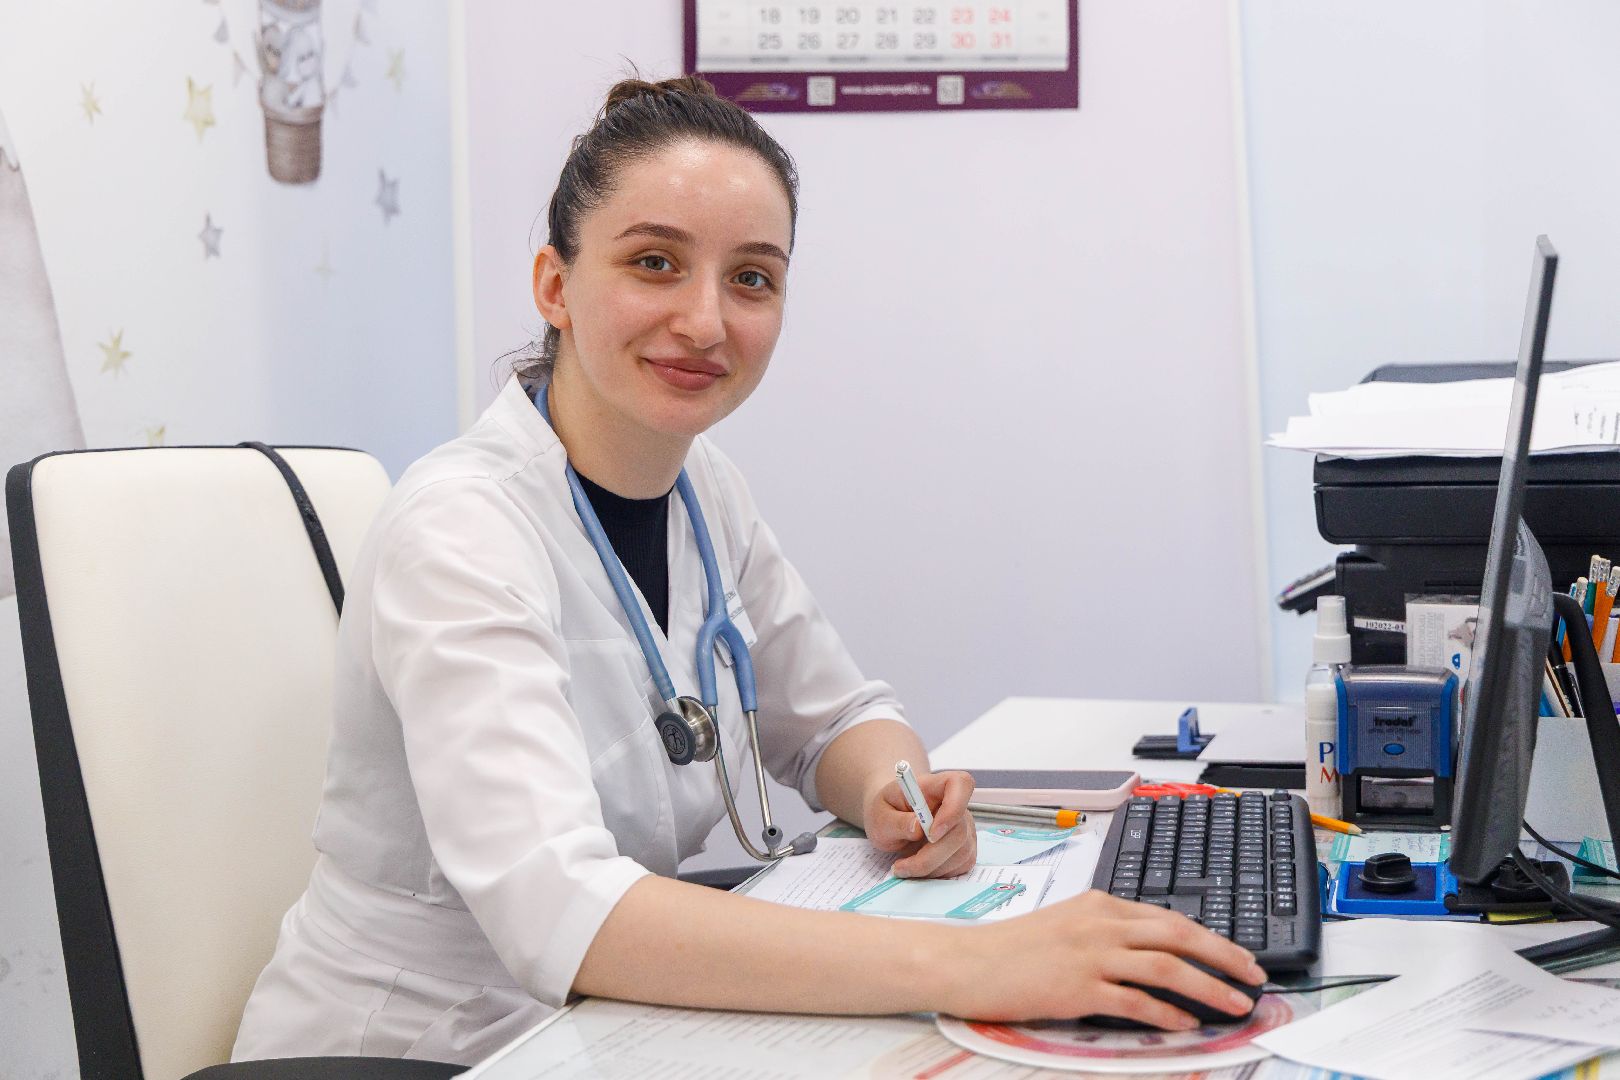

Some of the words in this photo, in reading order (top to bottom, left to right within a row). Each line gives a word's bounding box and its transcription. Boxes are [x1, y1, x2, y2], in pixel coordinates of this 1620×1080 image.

[760, 7, 781, 25] 18
[799, 7, 821, 25] 19
[836, 7, 860, 25] 20
[876, 7, 897, 25] 21
[912, 8, 936, 25] 22
[952, 8, 974, 25] 23
[989, 8, 1011, 24] 24
[757, 32, 783, 51] 25
[797, 32, 822, 51] 26
[836, 33, 860, 51] 27
[874, 32, 899, 50] 28
[913, 32, 938, 50] 29
[952, 32, 977, 50] 30
[991, 32, 1011, 49] 31
[1374, 715, 1416, 728] trodat
